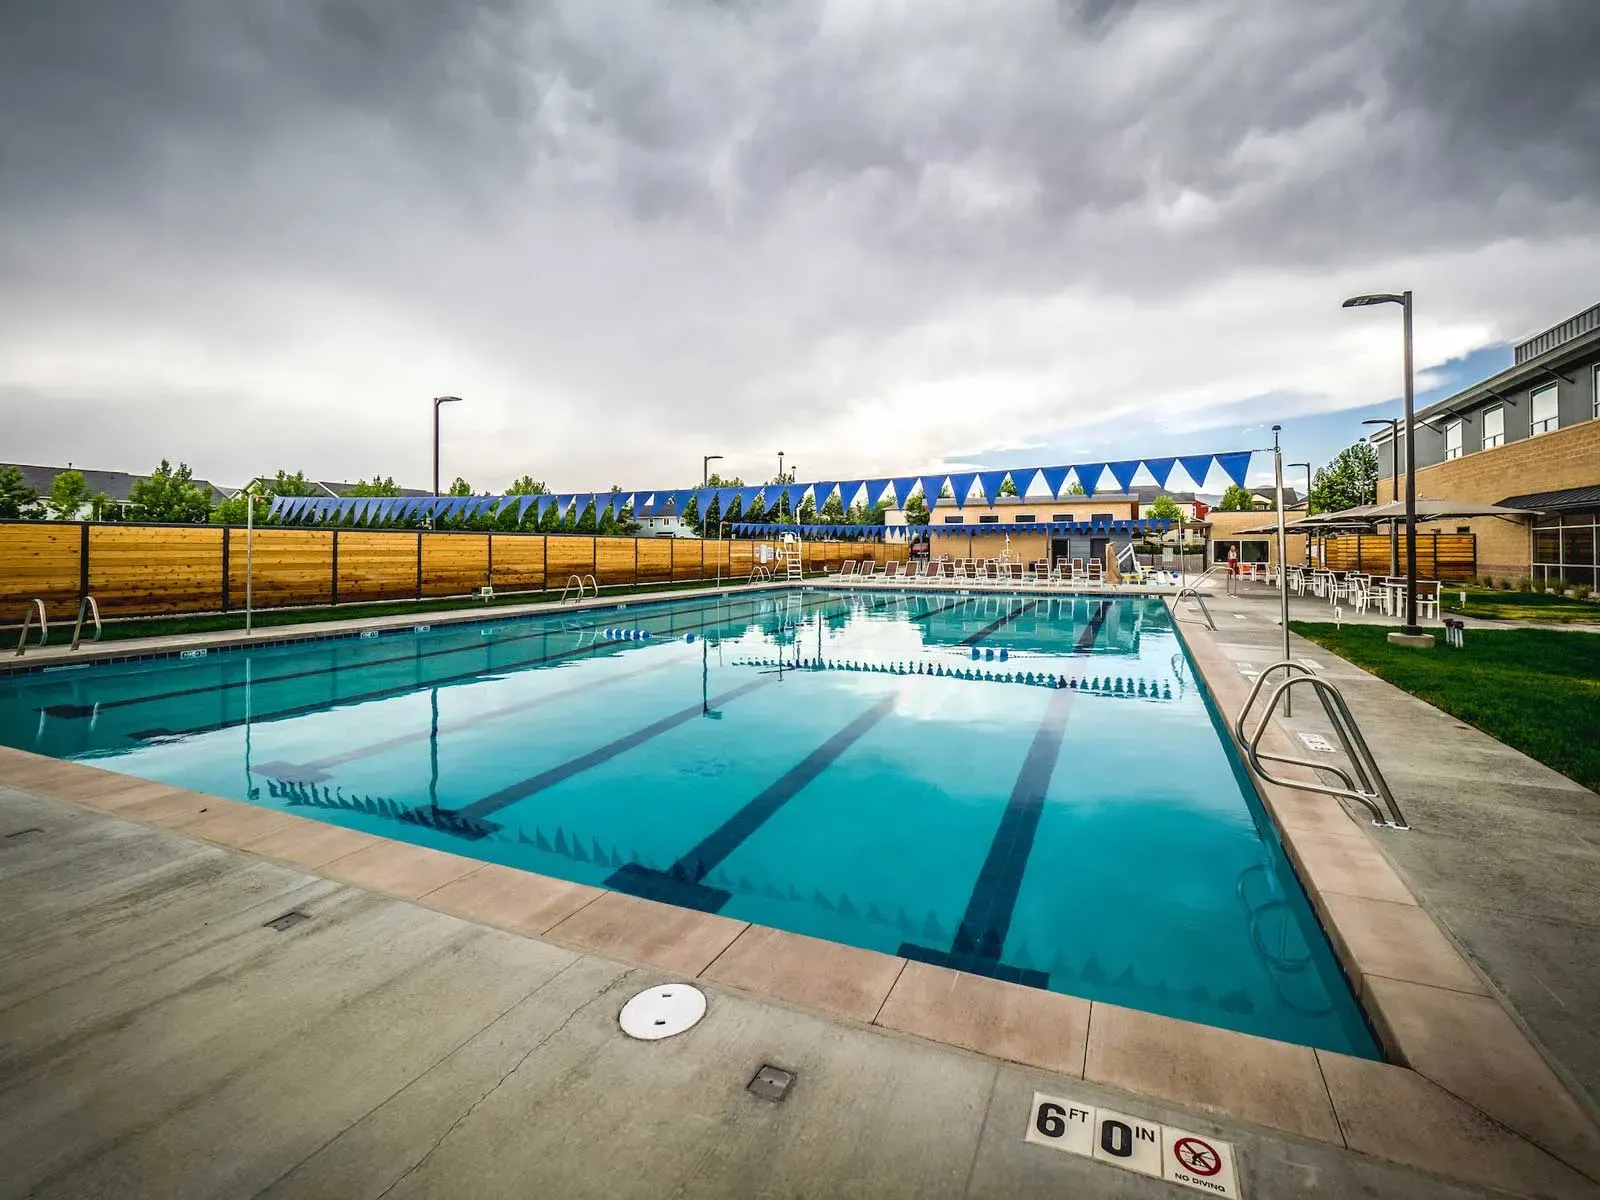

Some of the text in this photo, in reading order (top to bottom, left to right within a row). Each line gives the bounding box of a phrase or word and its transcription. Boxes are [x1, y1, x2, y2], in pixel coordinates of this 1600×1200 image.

[1037, 1103, 1155, 1157] 6 FT 0 IN
[1175, 1172, 1226, 1193] NO DIVING
